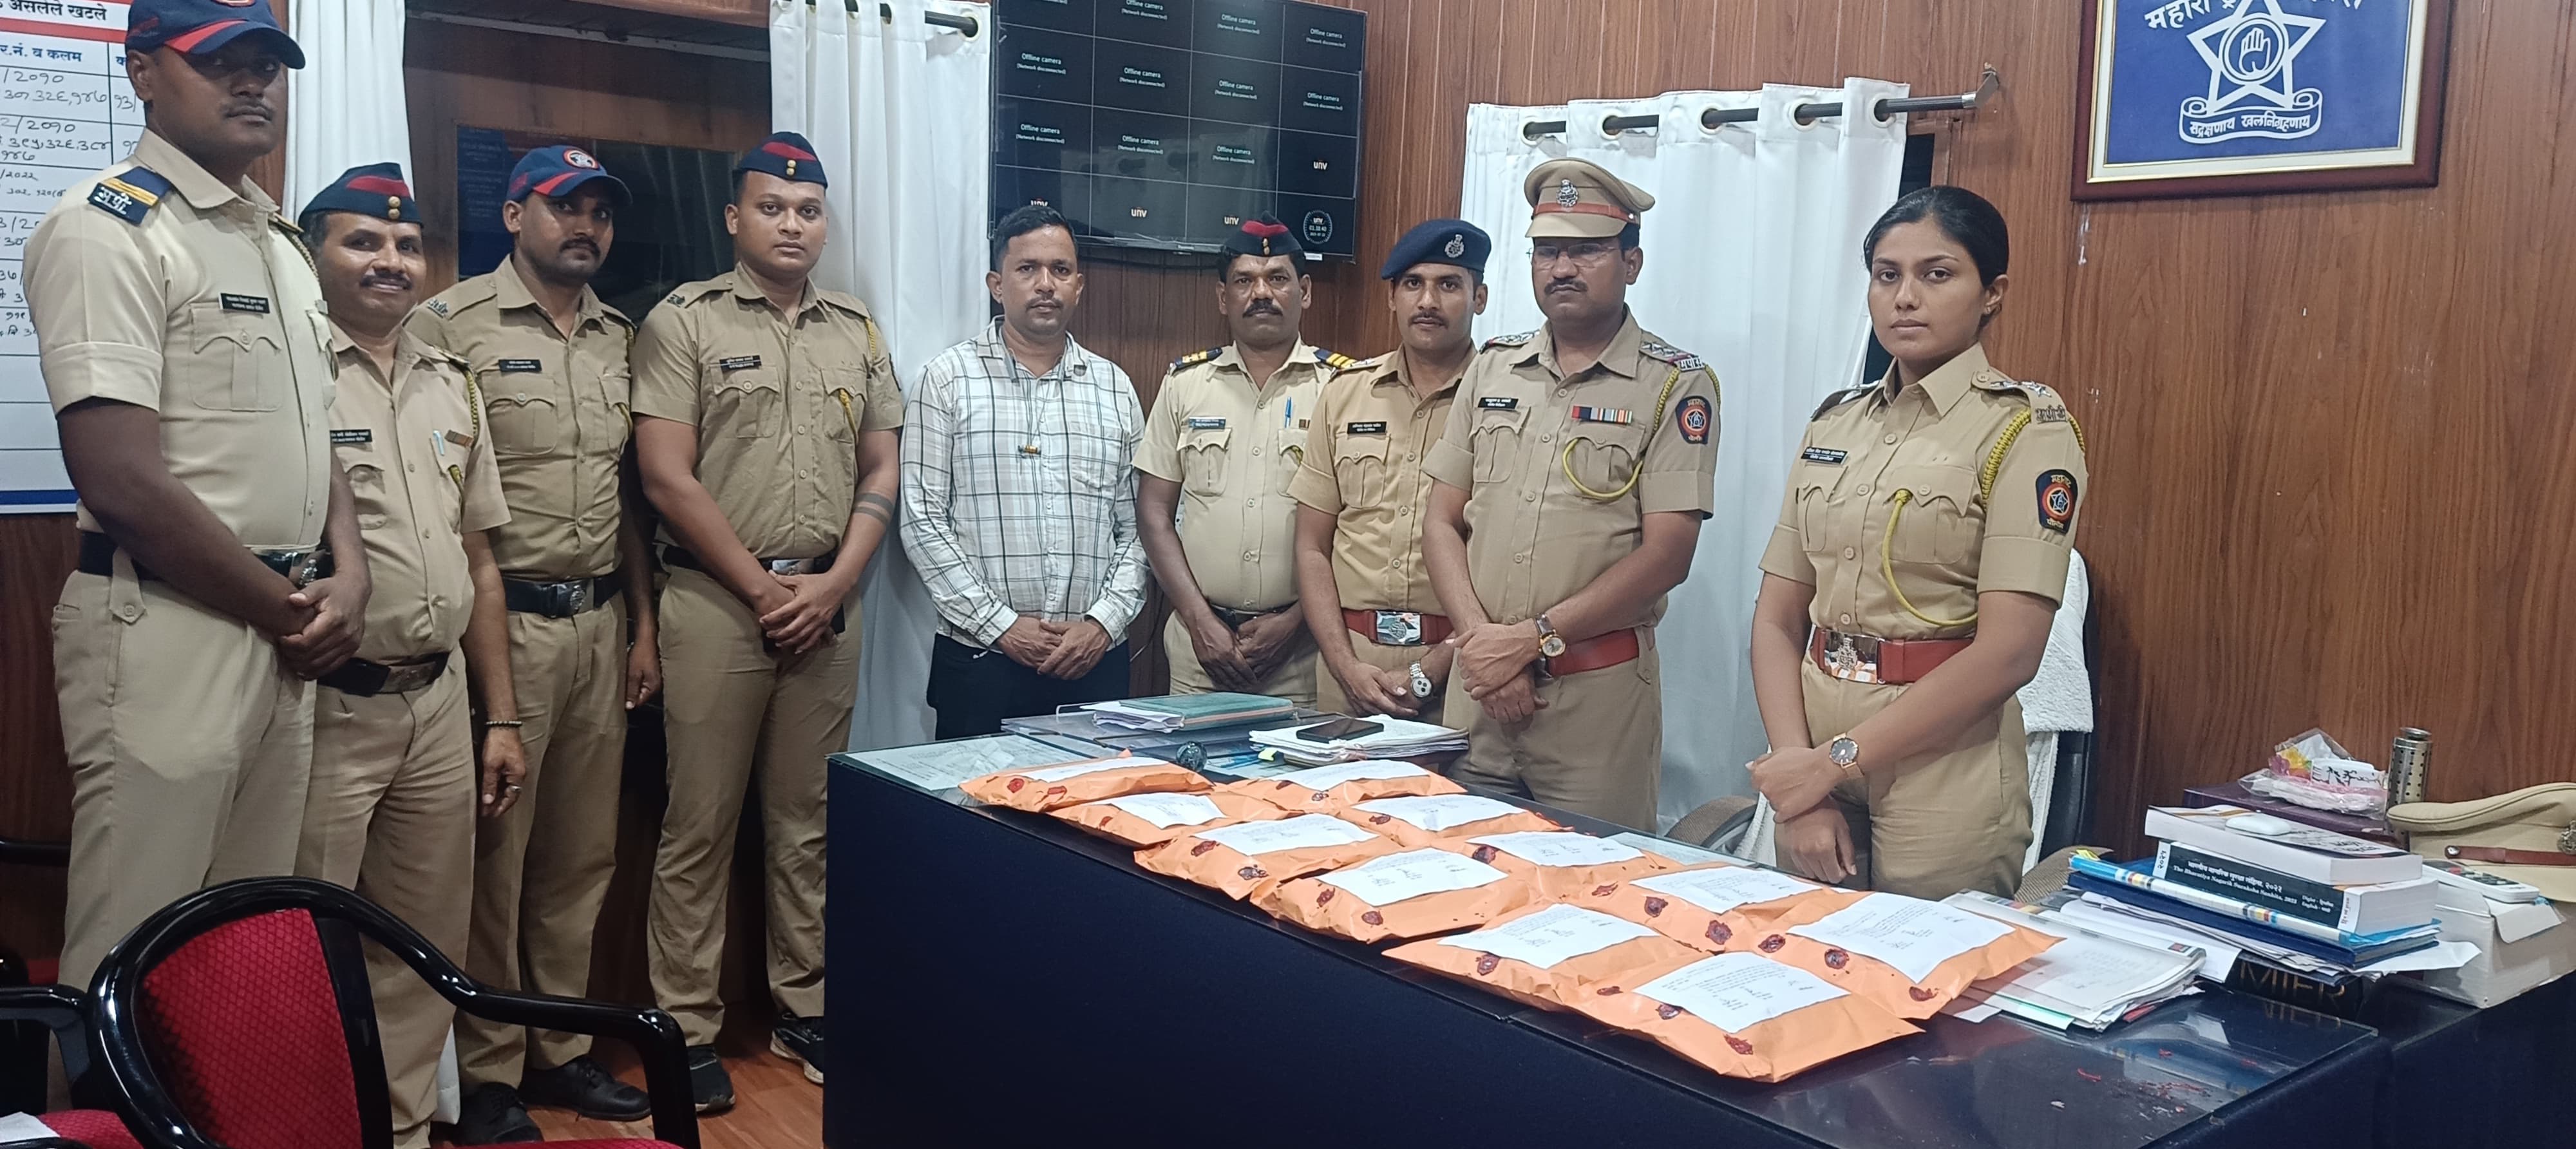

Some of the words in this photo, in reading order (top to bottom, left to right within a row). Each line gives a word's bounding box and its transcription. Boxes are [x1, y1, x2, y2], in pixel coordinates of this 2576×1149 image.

[1144, 2, 1163, 10] camera
[68, 3, 107, 21] खटले
[1222, 14, 1238, 23] Offline
[1238, 16, 1256, 25] camera
[1310, 28, 1325, 37] Offline
[46, 49, 82, 62] कलम
[1021, 52, 1039, 62] Offline
[1041, 55, 1061, 64] camera
[1124, 67, 1141, 77] Offline
[1142, 70, 1160, 79] camera
[1218, 80, 1235, 89] Offline
[1236, 82, 1253, 91] camera
[1307, 91, 1322, 101] Offline
[1021, 123, 1039, 132] Offline
[1040, 126, 1060, 135] camera
[1122, 135, 1139, 144] Offline
[1141, 137, 1159, 146] camera
[1217, 145, 1233, 155] Offline
[1233, 147, 1251, 156] camera
[1313, 160, 1328, 170] unv
[1131, 208, 1148, 218] unv
[1224, 216, 1239, 225] unv
